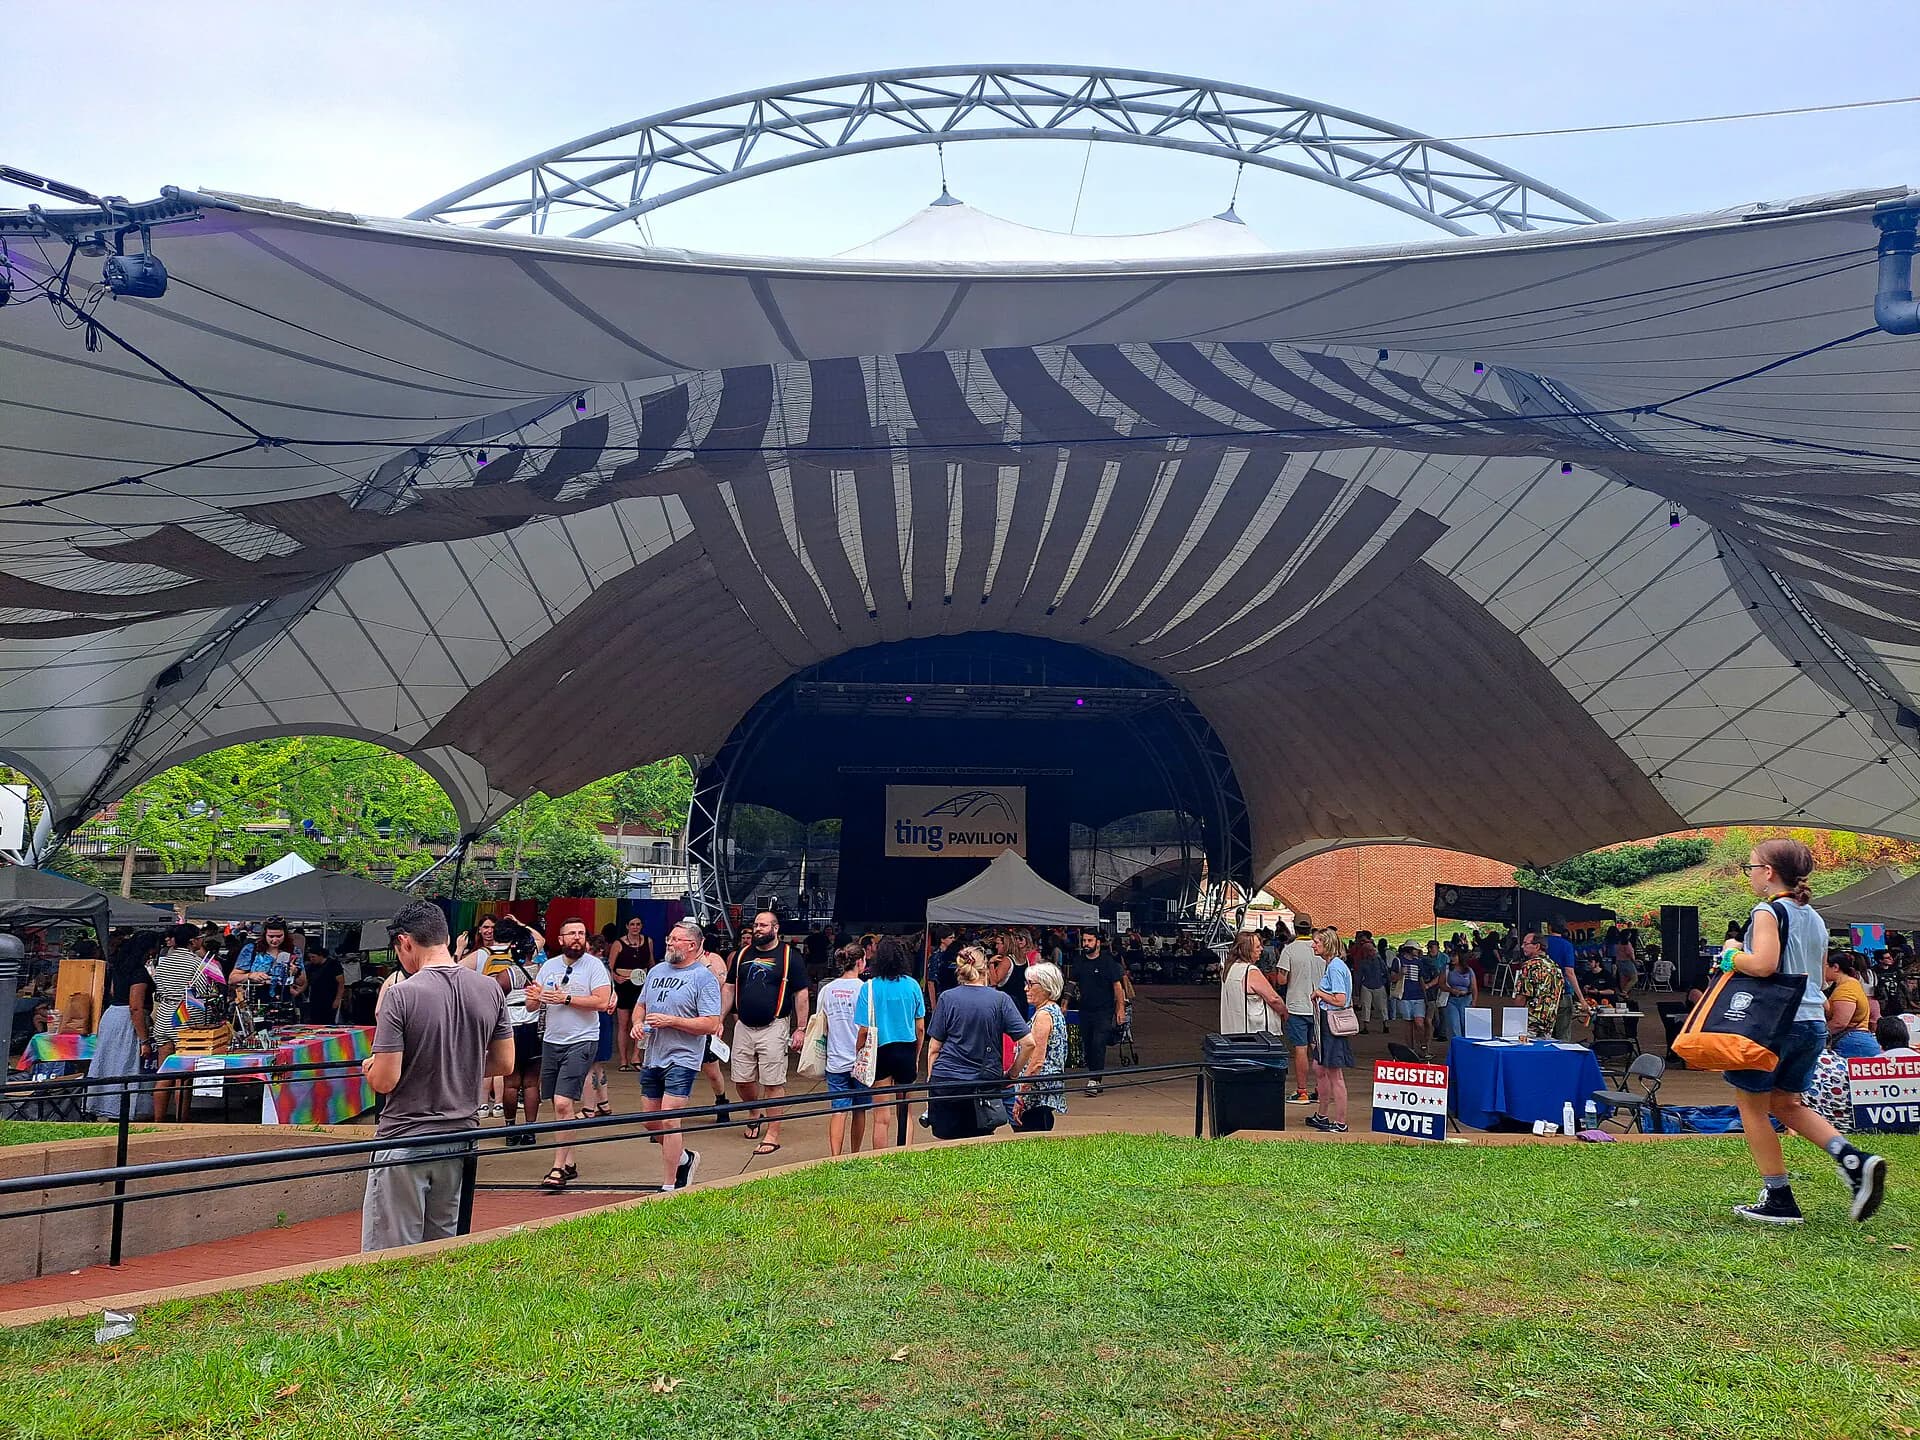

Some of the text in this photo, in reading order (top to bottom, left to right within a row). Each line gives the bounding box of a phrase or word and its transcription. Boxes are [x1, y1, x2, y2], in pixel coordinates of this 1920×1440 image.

[894, 819, 1018, 852] ting PAVILION
[651, 977, 688, 990] DADDY
[656, 990, 669, 1003] AF
[1376, 1065, 1446, 1085] REGISTER
[1851, 1061, 1920, 1077] REGISTER
[1399, 1090, 1418, 1106] TO
[1879, 1084, 1900, 1098] TO
[1866, 1105, 1920, 1124] VOTE
[1384, 1111, 1433, 1135] VOTE
